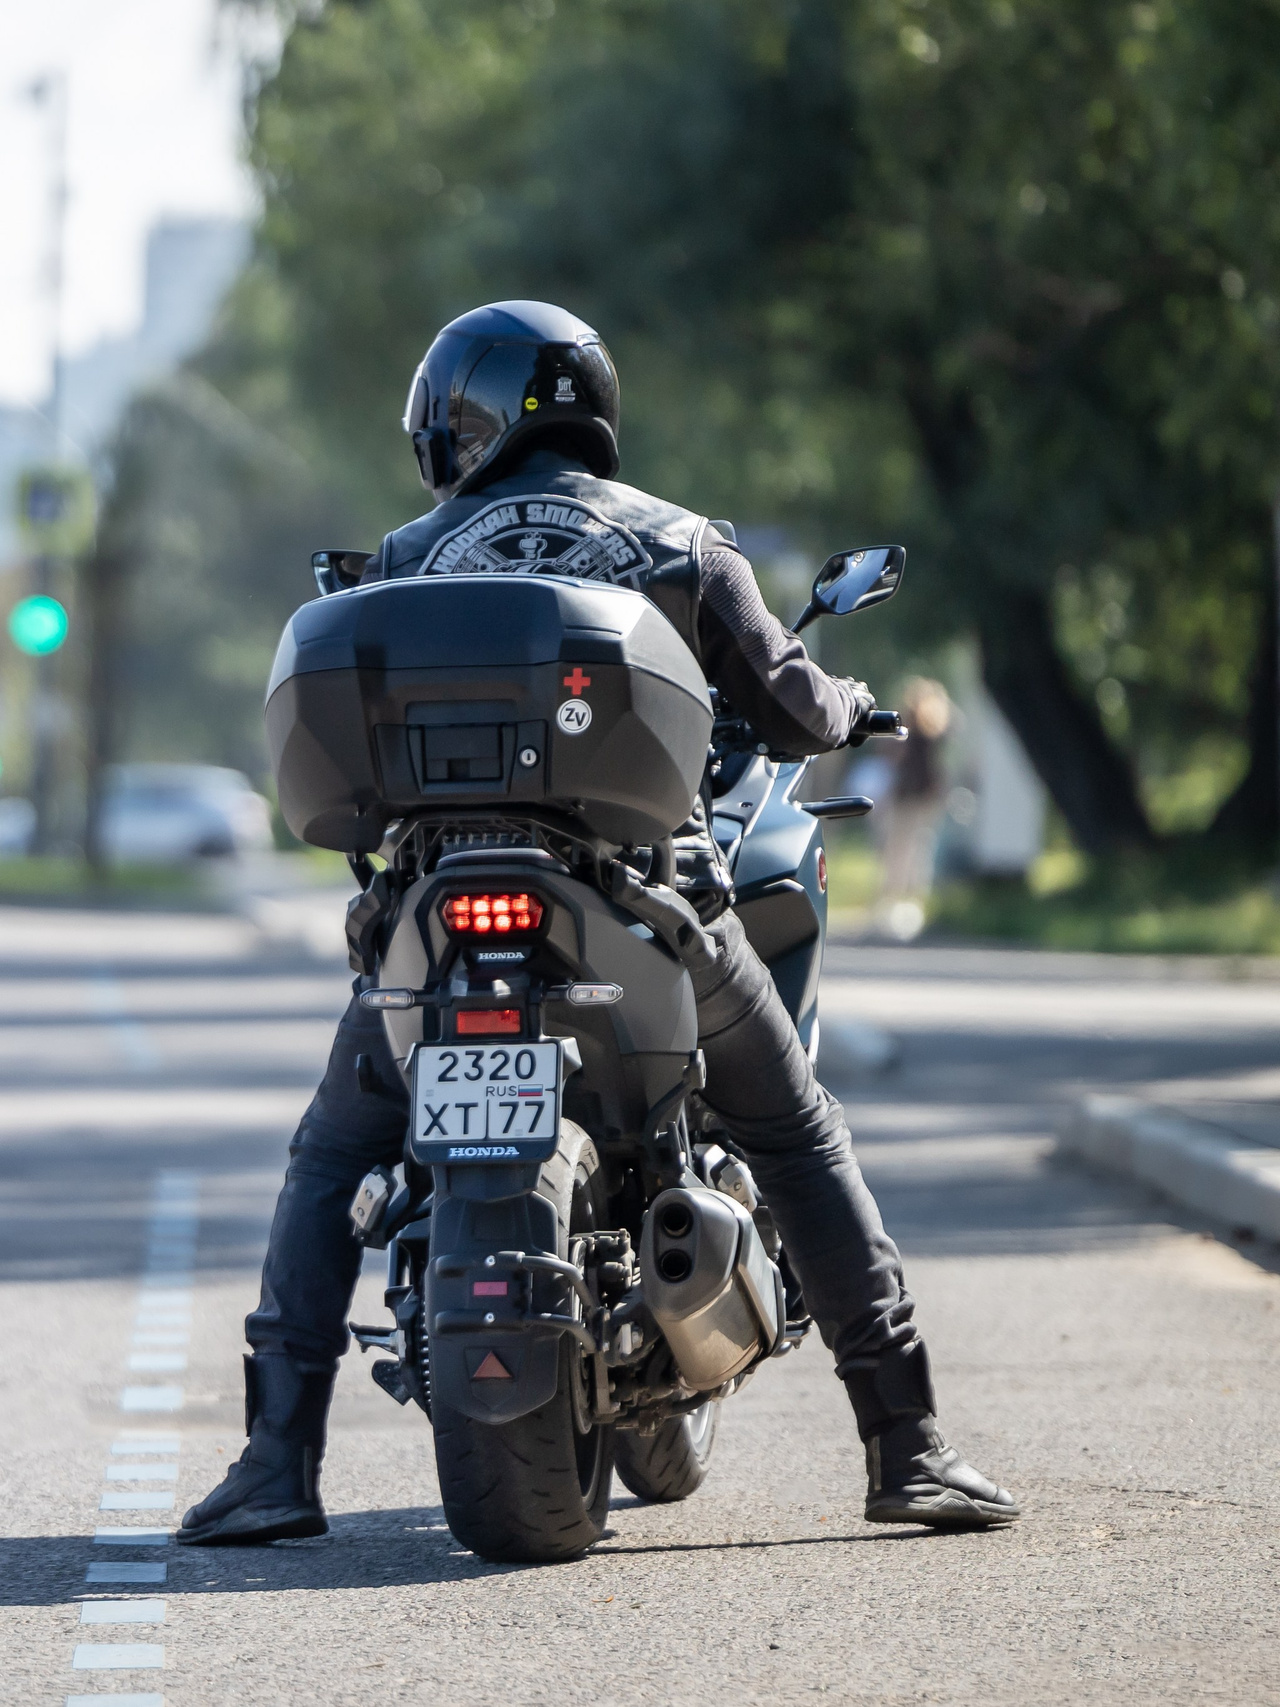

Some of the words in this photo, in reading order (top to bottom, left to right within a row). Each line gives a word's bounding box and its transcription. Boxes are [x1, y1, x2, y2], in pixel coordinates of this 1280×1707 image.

[431, 504, 521, 574] HOOKAH
[526, 504, 636, 566] SMOKERS
[478, 952, 525, 960] HONDA
[437, 1049, 537, 1082] 2320
[485, 1085, 517, 1097] RUS
[422, 1102, 479, 1136] XT
[498, 1100, 546, 1134] 77
[449, 1147, 520, 1157] HONDA
